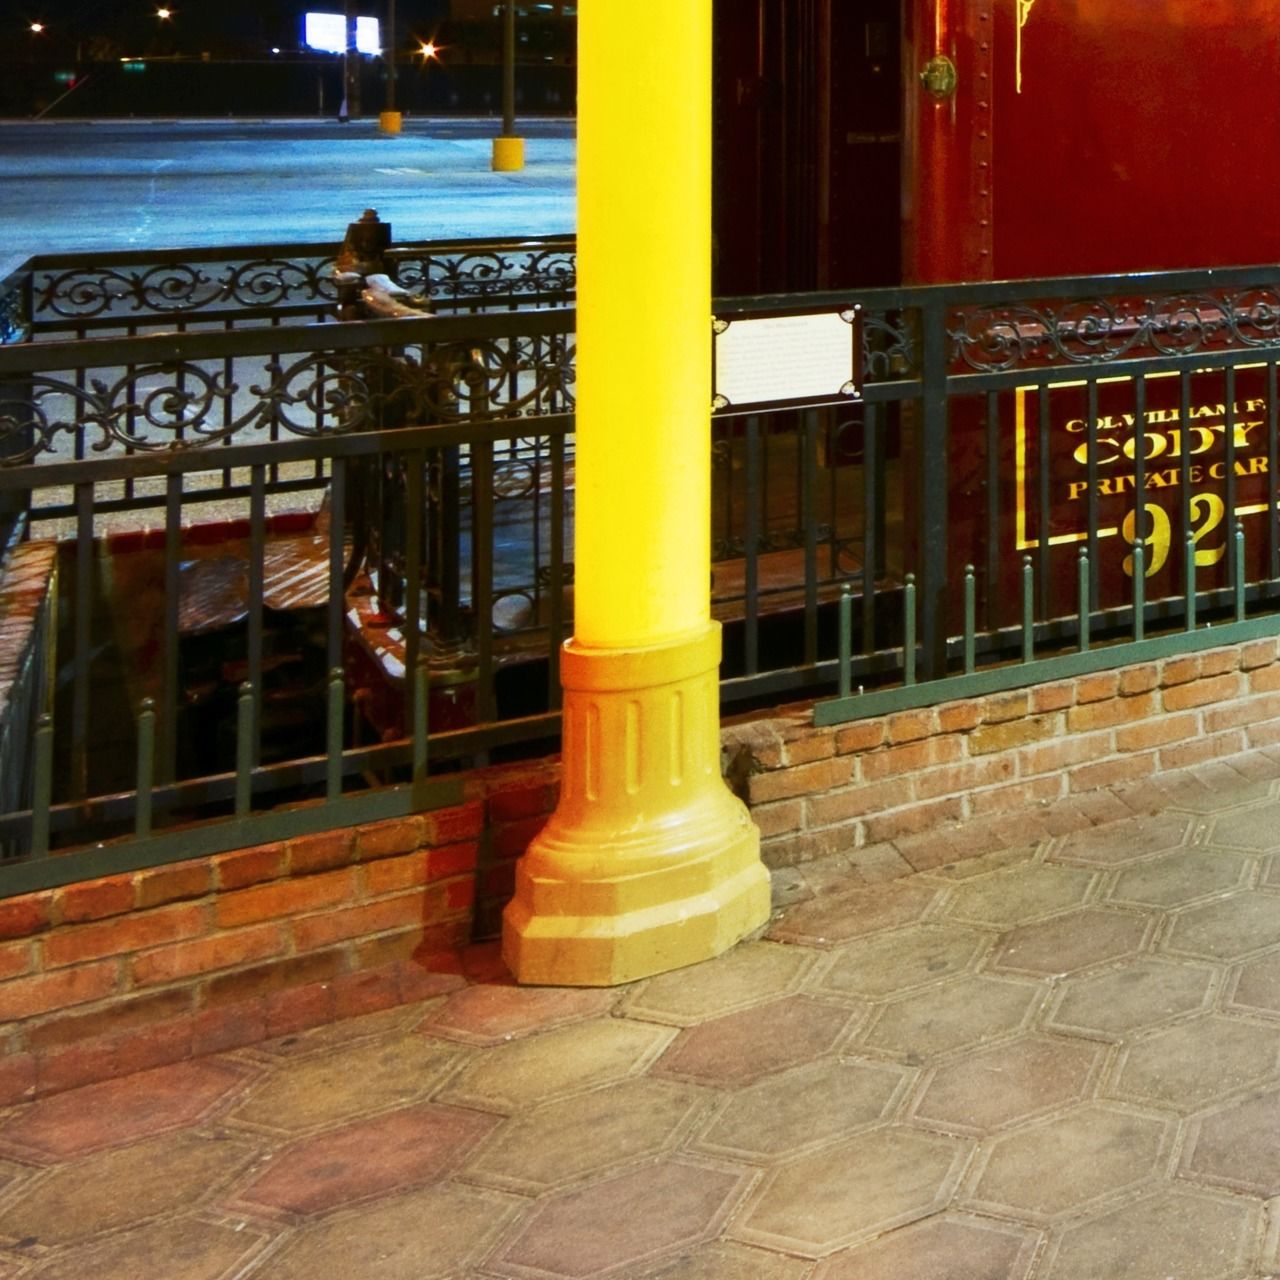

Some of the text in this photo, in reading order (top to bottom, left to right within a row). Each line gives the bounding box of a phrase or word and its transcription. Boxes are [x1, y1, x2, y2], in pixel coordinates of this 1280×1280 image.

[1073, 420, 1264, 465] CODY
[1067, 455, 1269, 500] PRIVATE CAR
[1122, 492, 1226, 578] 92
